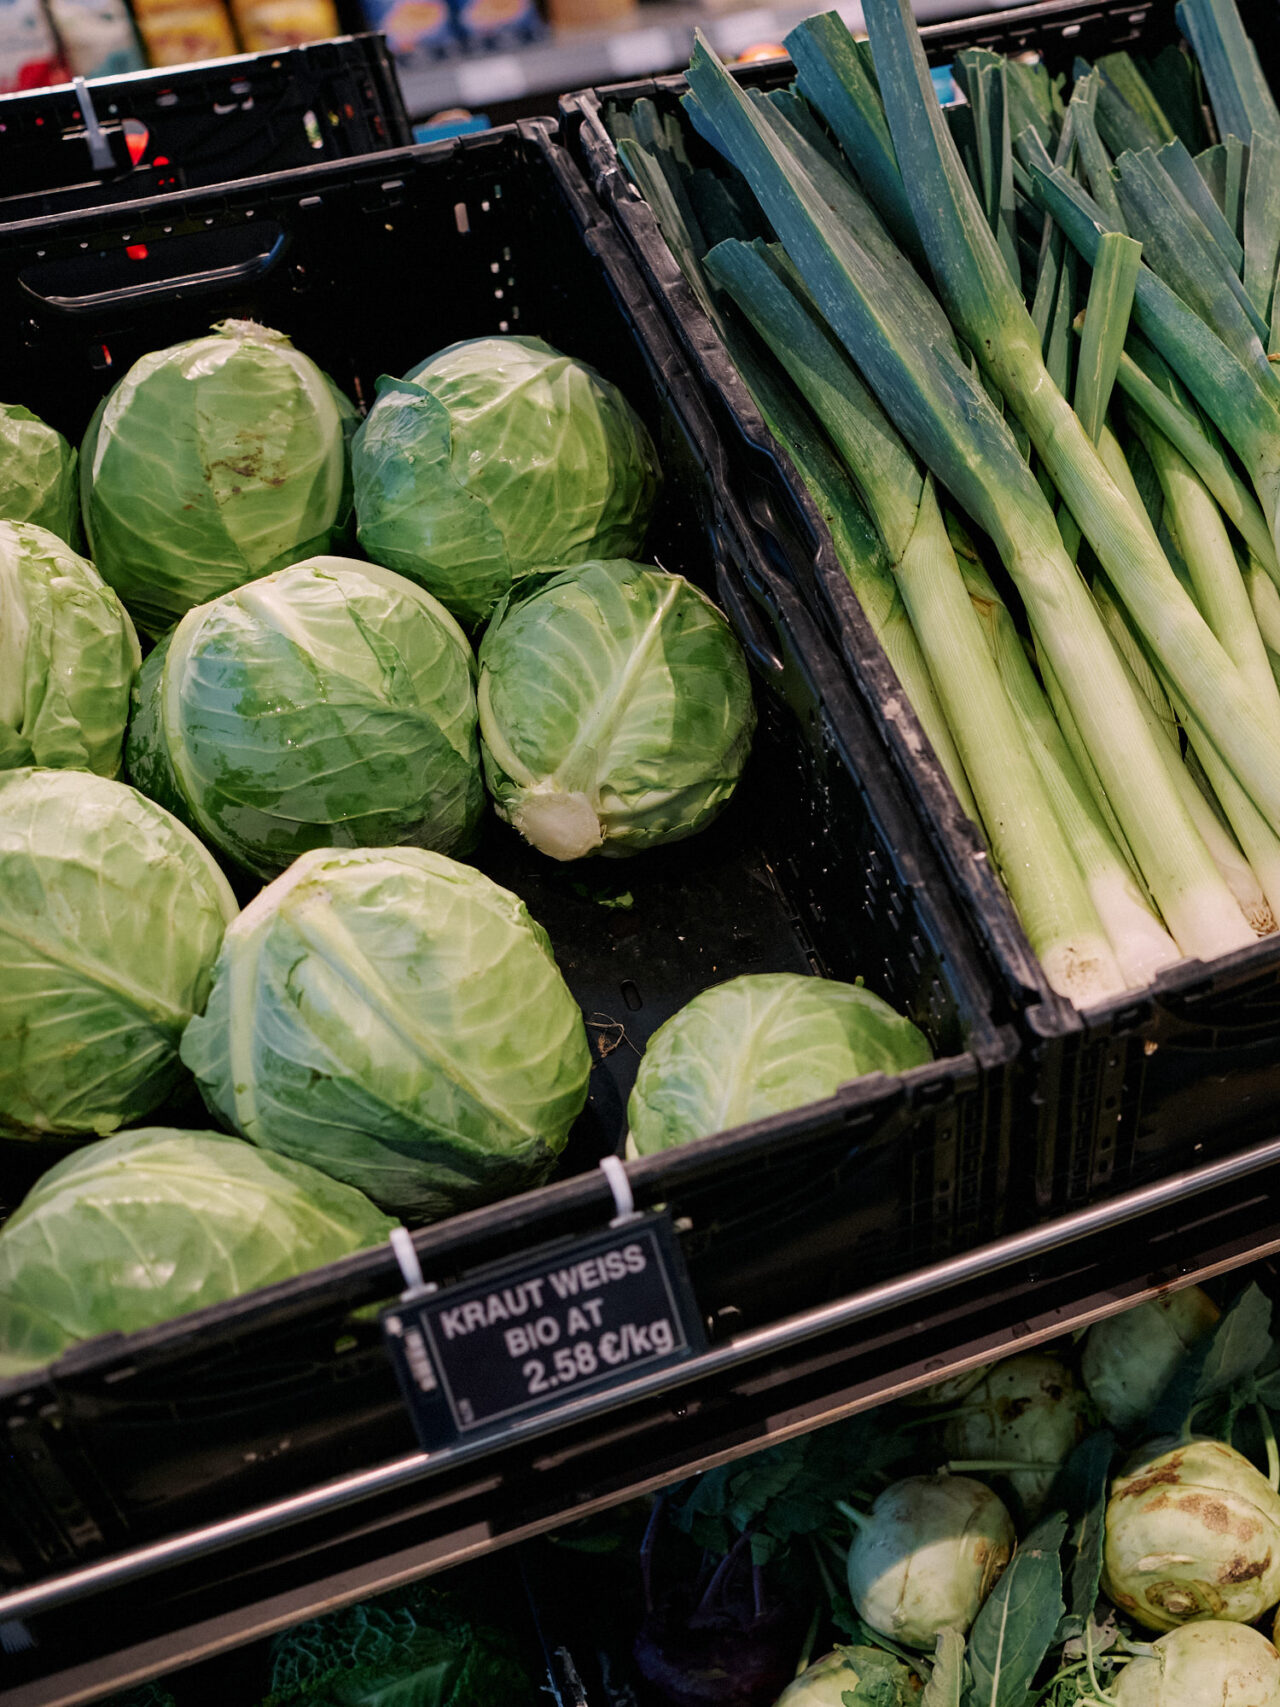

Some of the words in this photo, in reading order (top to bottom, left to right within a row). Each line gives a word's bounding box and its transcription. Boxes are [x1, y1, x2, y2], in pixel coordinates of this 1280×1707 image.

[440, 1279, 545, 1339] KRAUT
[549, 1245, 646, 1298] WEISS
[504, 1317, 559, 1357] BIO
[567, 1299, 604, 1336] AT
